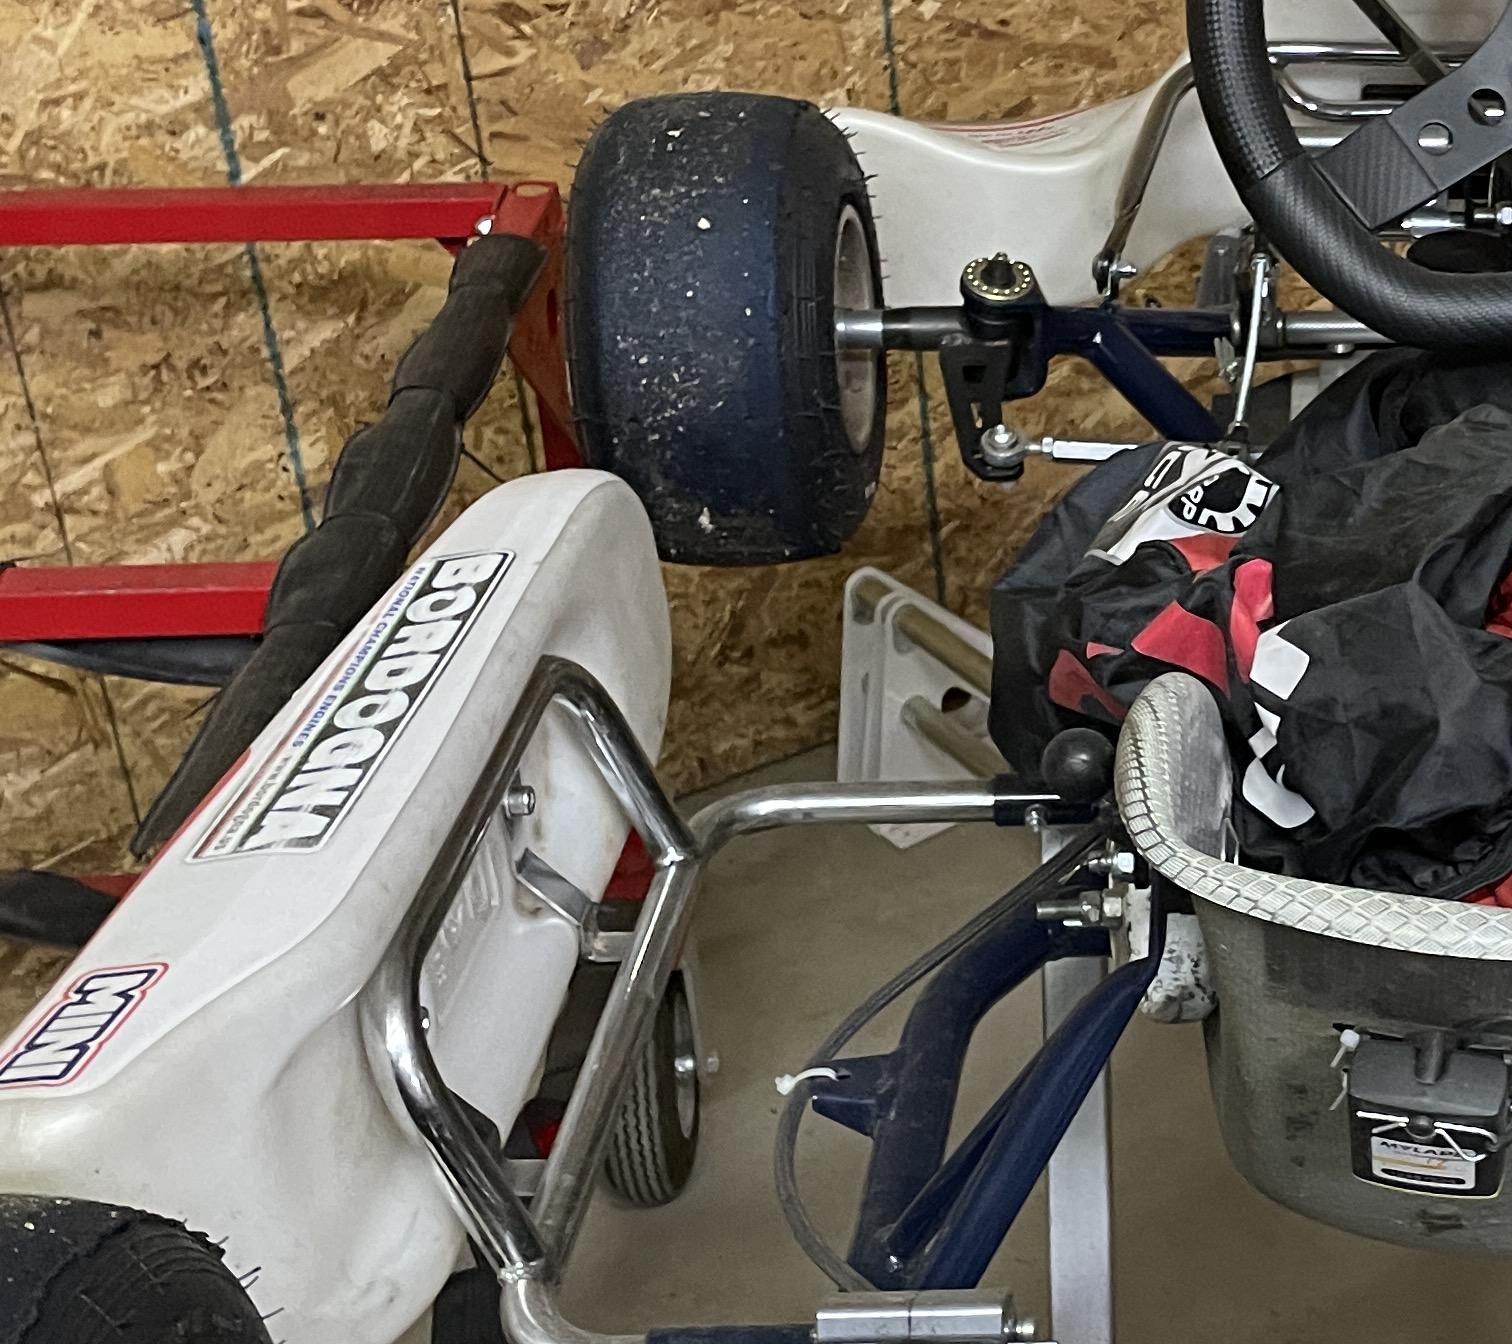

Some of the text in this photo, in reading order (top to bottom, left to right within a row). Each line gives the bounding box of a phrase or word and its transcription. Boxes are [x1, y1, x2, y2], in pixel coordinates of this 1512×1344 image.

[240, 553, 504, 851] BORDOGNA
[291, 566, 426, 748] NATIONAL CHAMPIONS ENGINES
[0, 969, 157, 1082] MINI
